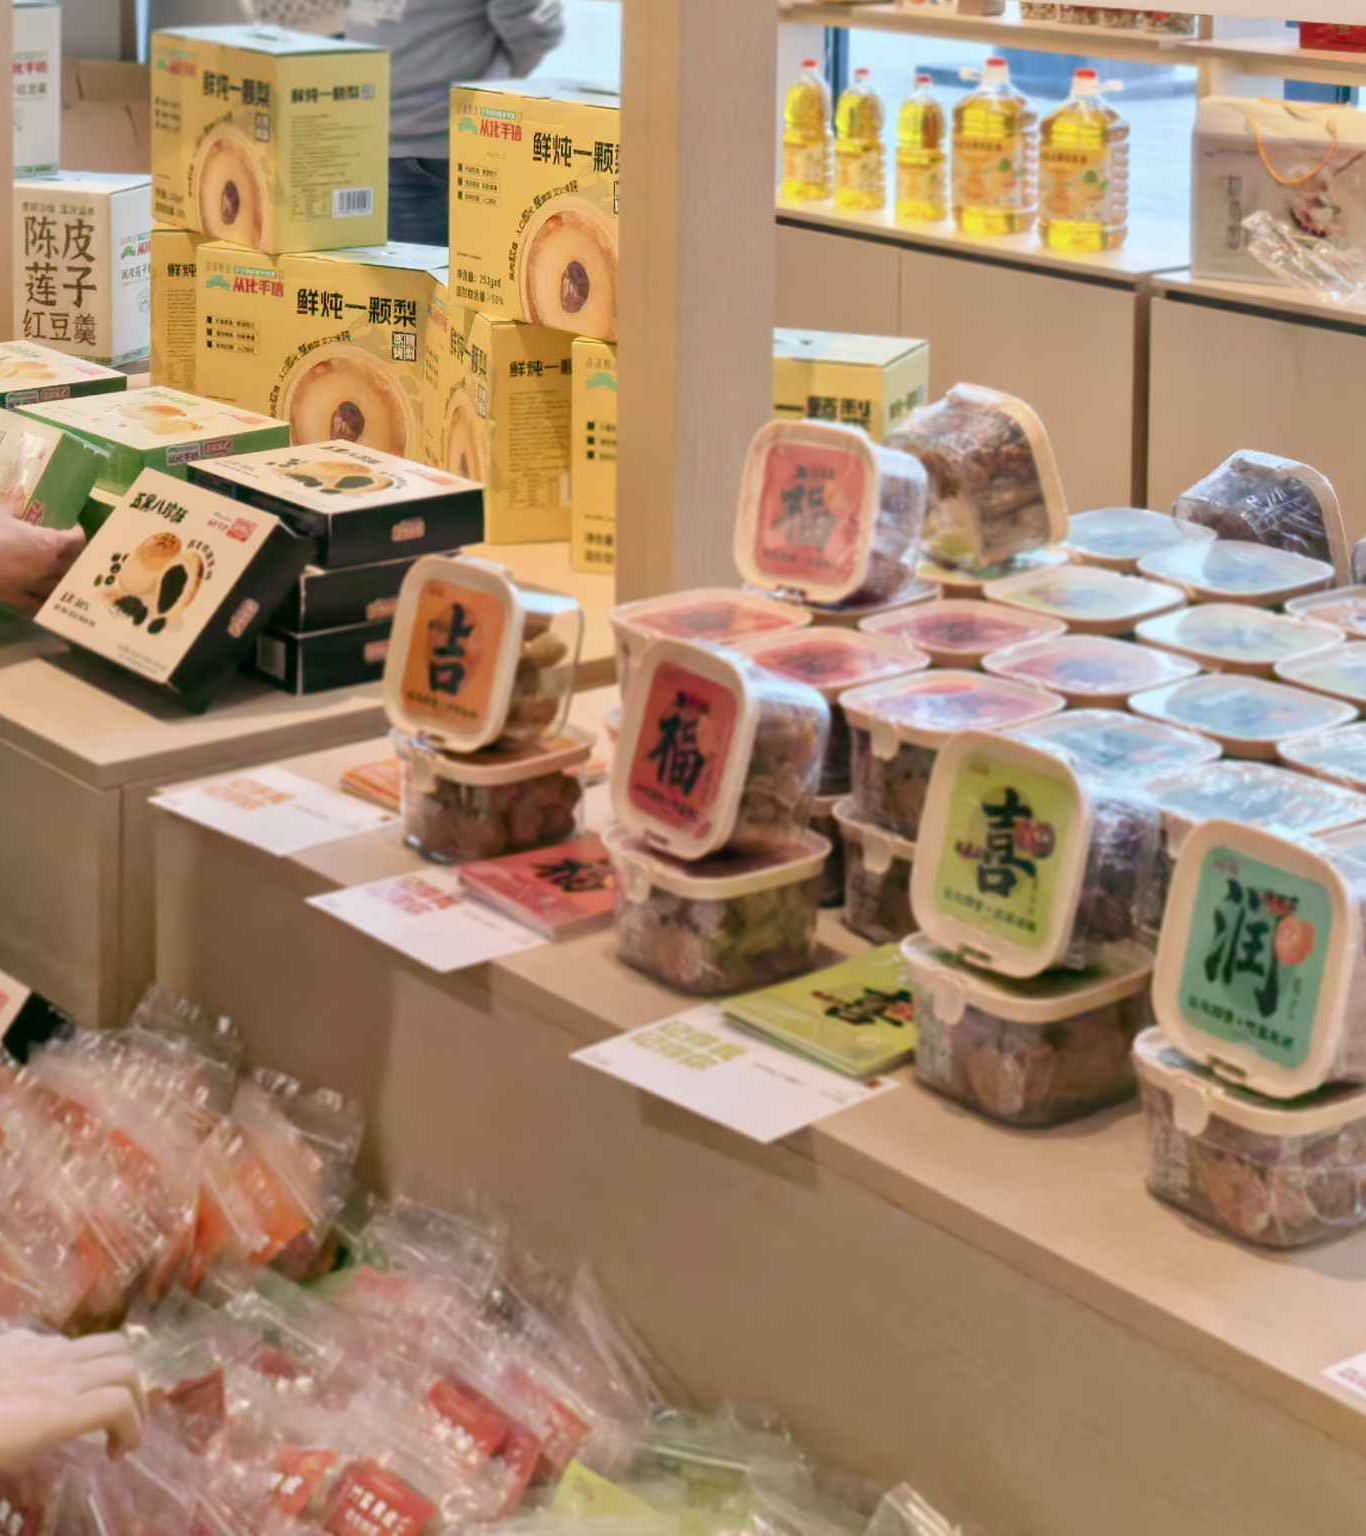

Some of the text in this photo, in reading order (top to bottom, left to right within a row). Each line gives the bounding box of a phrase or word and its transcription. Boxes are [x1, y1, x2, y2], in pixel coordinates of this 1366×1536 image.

[24, 215, 96, 263] 陈皮
[24, 261, 98, 309] 莲子
[296, 288, 417, 328] 鲜炖一颗梨
[23, 308, 98, 346] 红豆羹
[647, 690, 709, 798] 福
[970, 785, 1043, 898] 喜
[1204, 878, 1301, 1019] 润
